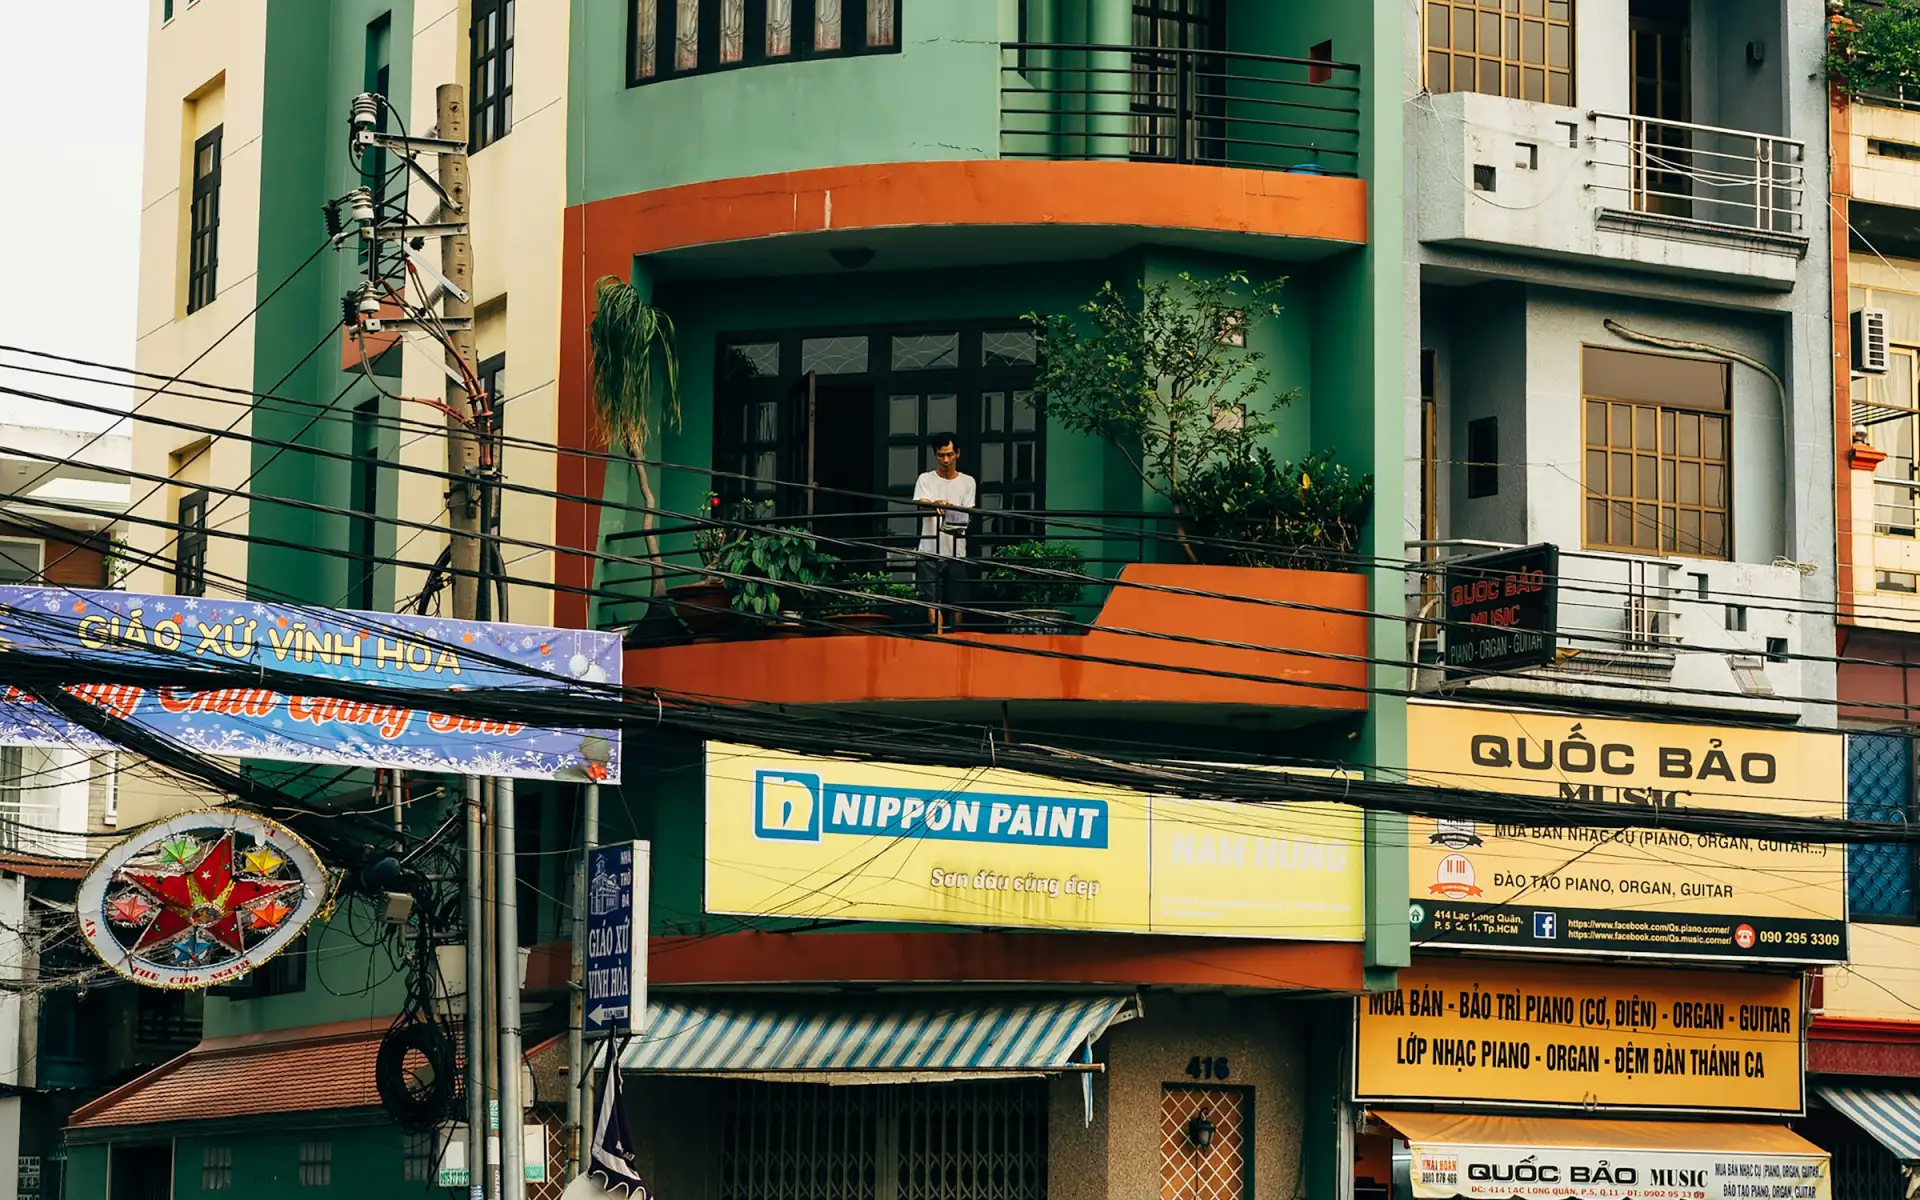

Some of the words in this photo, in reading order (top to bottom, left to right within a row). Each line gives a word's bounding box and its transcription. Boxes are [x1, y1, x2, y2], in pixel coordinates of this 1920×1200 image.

[78, 608, 184, 652] GIÁO
[196, 615, 259, 659] XỨ
[268, 622, 361, 667] VĨNH
[1451, 642, 1474, 664] PIANO
[1480, 636, 1507, 659] ORGAN
[1471, 722, 1635, 776] QUỐC
[1659, 738, 1776, 784] BẢO
[832, 793, 980, 832] NIPPON
[988, 802, 1099, 839] PAINT
[1172, 833, 1245, 867] NAM
[1568, 828, 1609, 845] NHẠC
[1640, 830, 1693, 848] (PIANO,
[1697, 833, 1753, 852] ORGAN,
[1494, 870, 1526, 888] ĐÀO
[1531, 875, 1561, 892] TẠO
[1566, 877, 1615, 895] PIANO,
[1619, 879, 1676, 897] ORGAN,
[1680, 882, 1733, 898] GUITAR
[1434, 910, 1451, 919] 414
[1453, 911, 1470, 921] Lạc
[1497, 913, 1524, 925] Quân,
[1483, 924, 1518, 934] Tp.HCM
[588, 919, 613, 958] GIÁO
[615, 916, 630, 955] XỨ
[1760, 931, 1782, 943] 090
[1785, 932, 1807, 944] 295
[1811, 933, 1840, 945] 3309
[610, 958, 629, 996] HÒA
[1368, 989, 1404, 1016] MUA
[1410, 984, 1443, 1017] BÁN
[1459, 983, 1491, 1020] BẢO
[1496, 988, 1521, 1021] TRÌ
[1526, 995, 1574, 1024] PIANO
[1580, 996, 1610, 1030] (CƠ,
[1615, 994, 1657, 1032] ĐIỆN)
[1673, 1001, 1724, 1030] ORGAN
[1740, 1004, 1790, 1033] GUITAR
[1186, 1055, 1230, 1080] 416
[1397, 1032, 1427, 1064] LỚP
[1432, 1038, 1476, 1072] NHẠC
[1482, 1041, 1530, 1069] PIANO
[1547, 1044, 1599, 1072] ORGAN
[1615, 1041, 1649, 1080] ĐỆM
[1654, 1043, 1685, 1075] ĐÀN
[1690, 1044, 1740, 1077] THÁNH
[1745, 1052, 1764, 1078] CA
[1468, 1155, 1560, 1183] QUỐC
[1570, 1160, 1638, 1185] BẢO
[1650, 1168, 1708, 1188] MUSIC
[1527, 1187, 1551, 1195] LONG
[1600, 1189, 1618, 1197] Q.11
[1643, 1190, 1665, 1198] 0902
